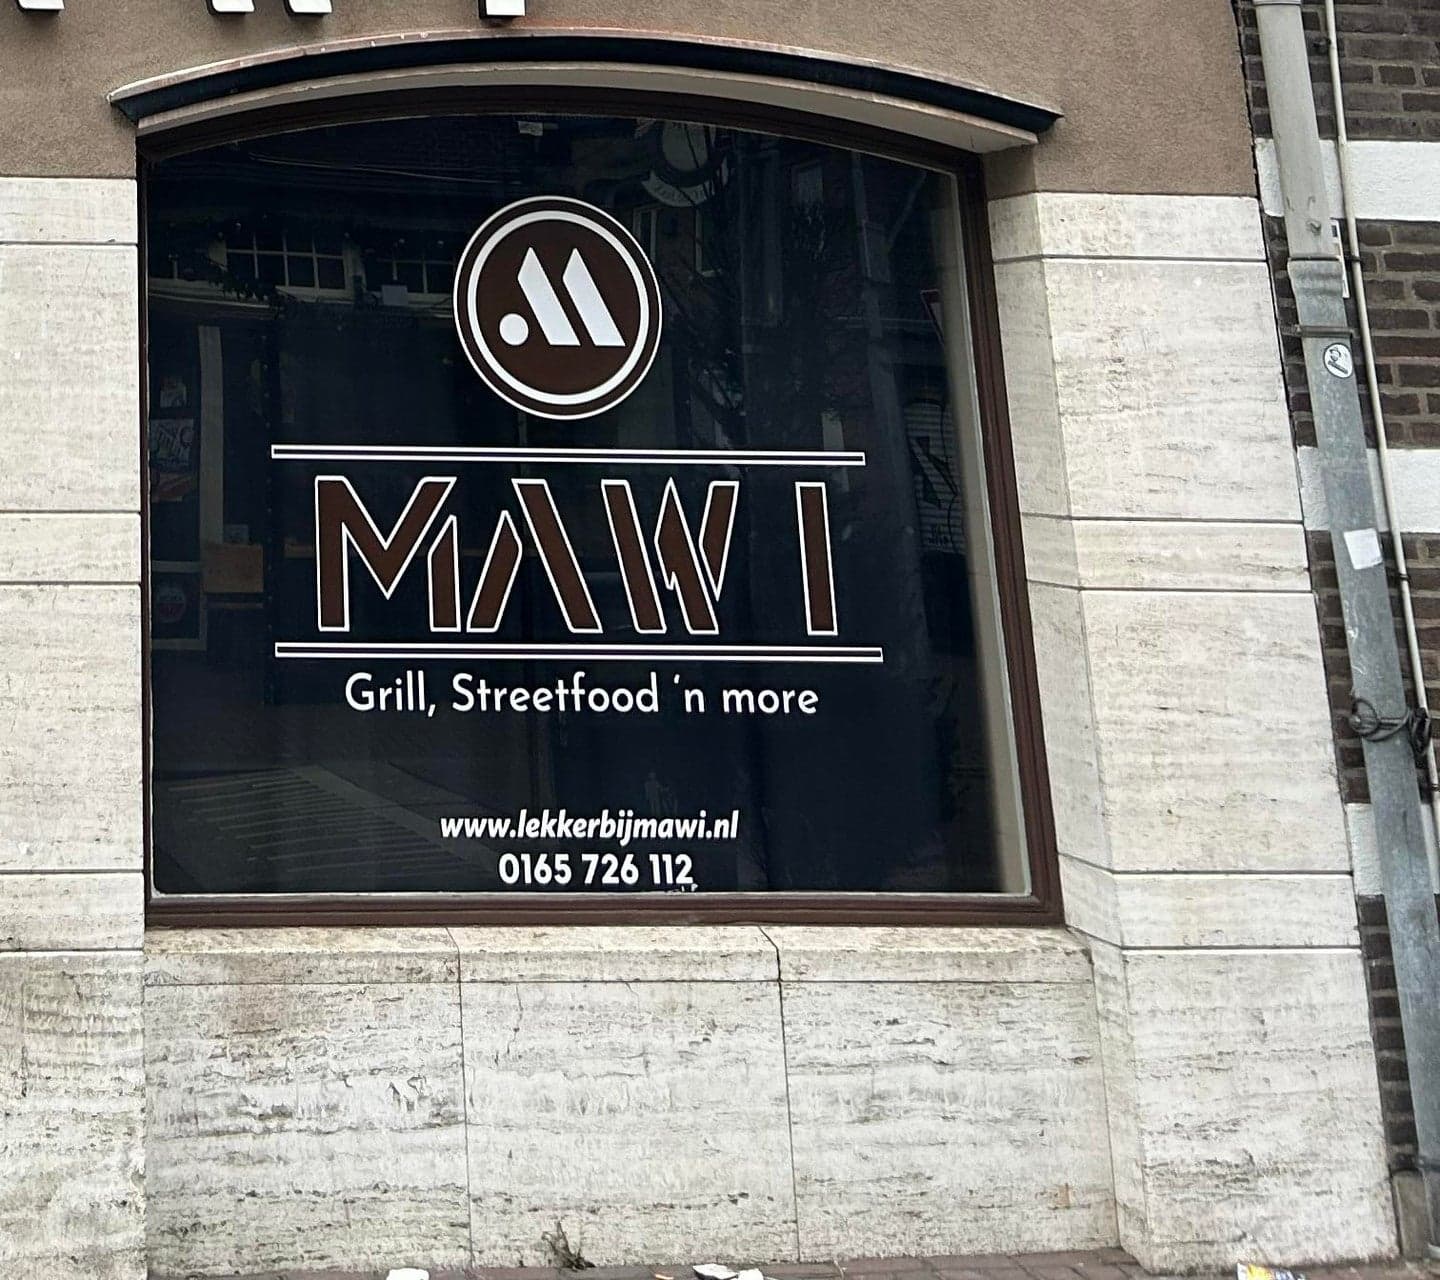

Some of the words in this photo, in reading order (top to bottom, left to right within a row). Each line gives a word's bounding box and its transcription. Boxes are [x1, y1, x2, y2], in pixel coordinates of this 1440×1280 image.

[314, 474, 839, 636] MAWI
[344, 671, 437, 718] Grill,
[451, 671, 660, 714] Streetfood
[721, 689, 820, 715] more
[440, 808, 740, 847] www.lekkerbijmawi.nl
[498, 853, 572, 885] 0165
[581, 853, 640, 885] 726
[648, 853, 694, 885] 112
